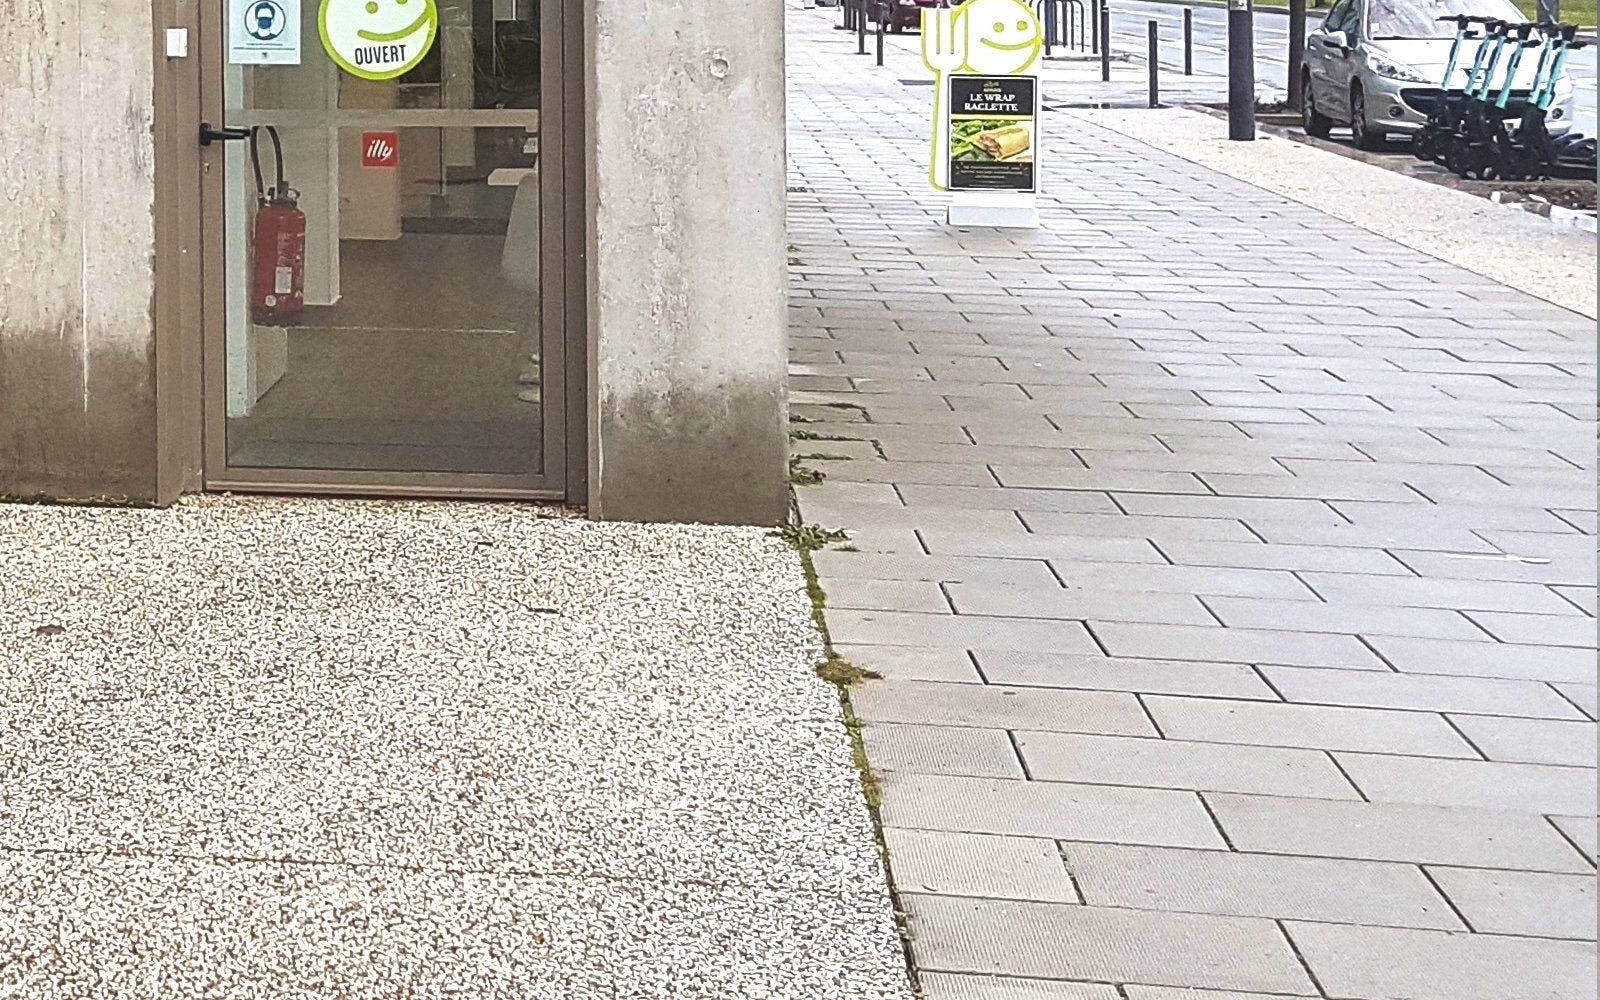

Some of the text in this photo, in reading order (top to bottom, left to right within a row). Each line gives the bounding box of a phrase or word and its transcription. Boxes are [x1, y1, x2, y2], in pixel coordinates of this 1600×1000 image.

[355, 44, 407, 65] OUVERT
[969, 93, 1016, 102] LE WRAP
[964, 102, 1019, 112] RACLETTE
[366, 139, 393, 162] illy
